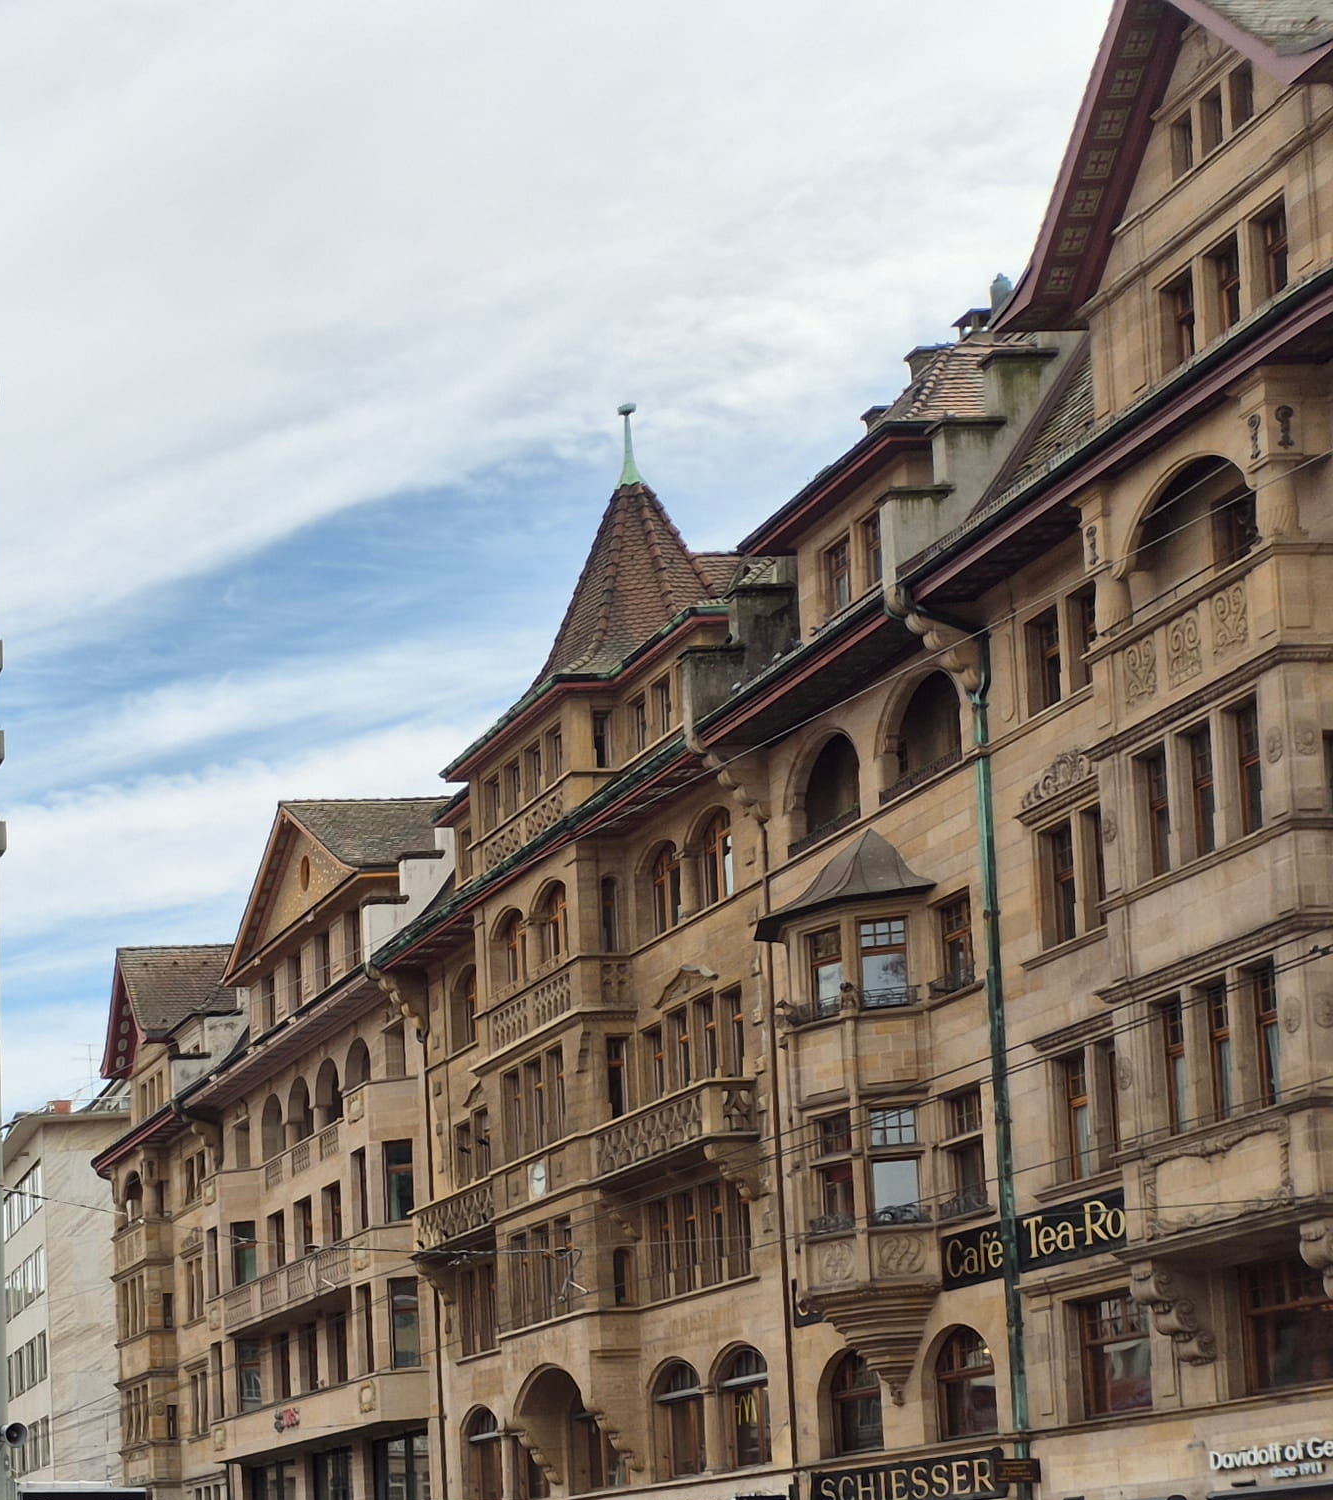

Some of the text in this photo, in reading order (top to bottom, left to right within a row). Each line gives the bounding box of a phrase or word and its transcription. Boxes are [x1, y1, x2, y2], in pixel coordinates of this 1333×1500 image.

[946, 1231, 1004, 1279] Café
[1209, 1442, 1282, 1471] Davidoff
[1284, 1439, 1304, 1462] of
